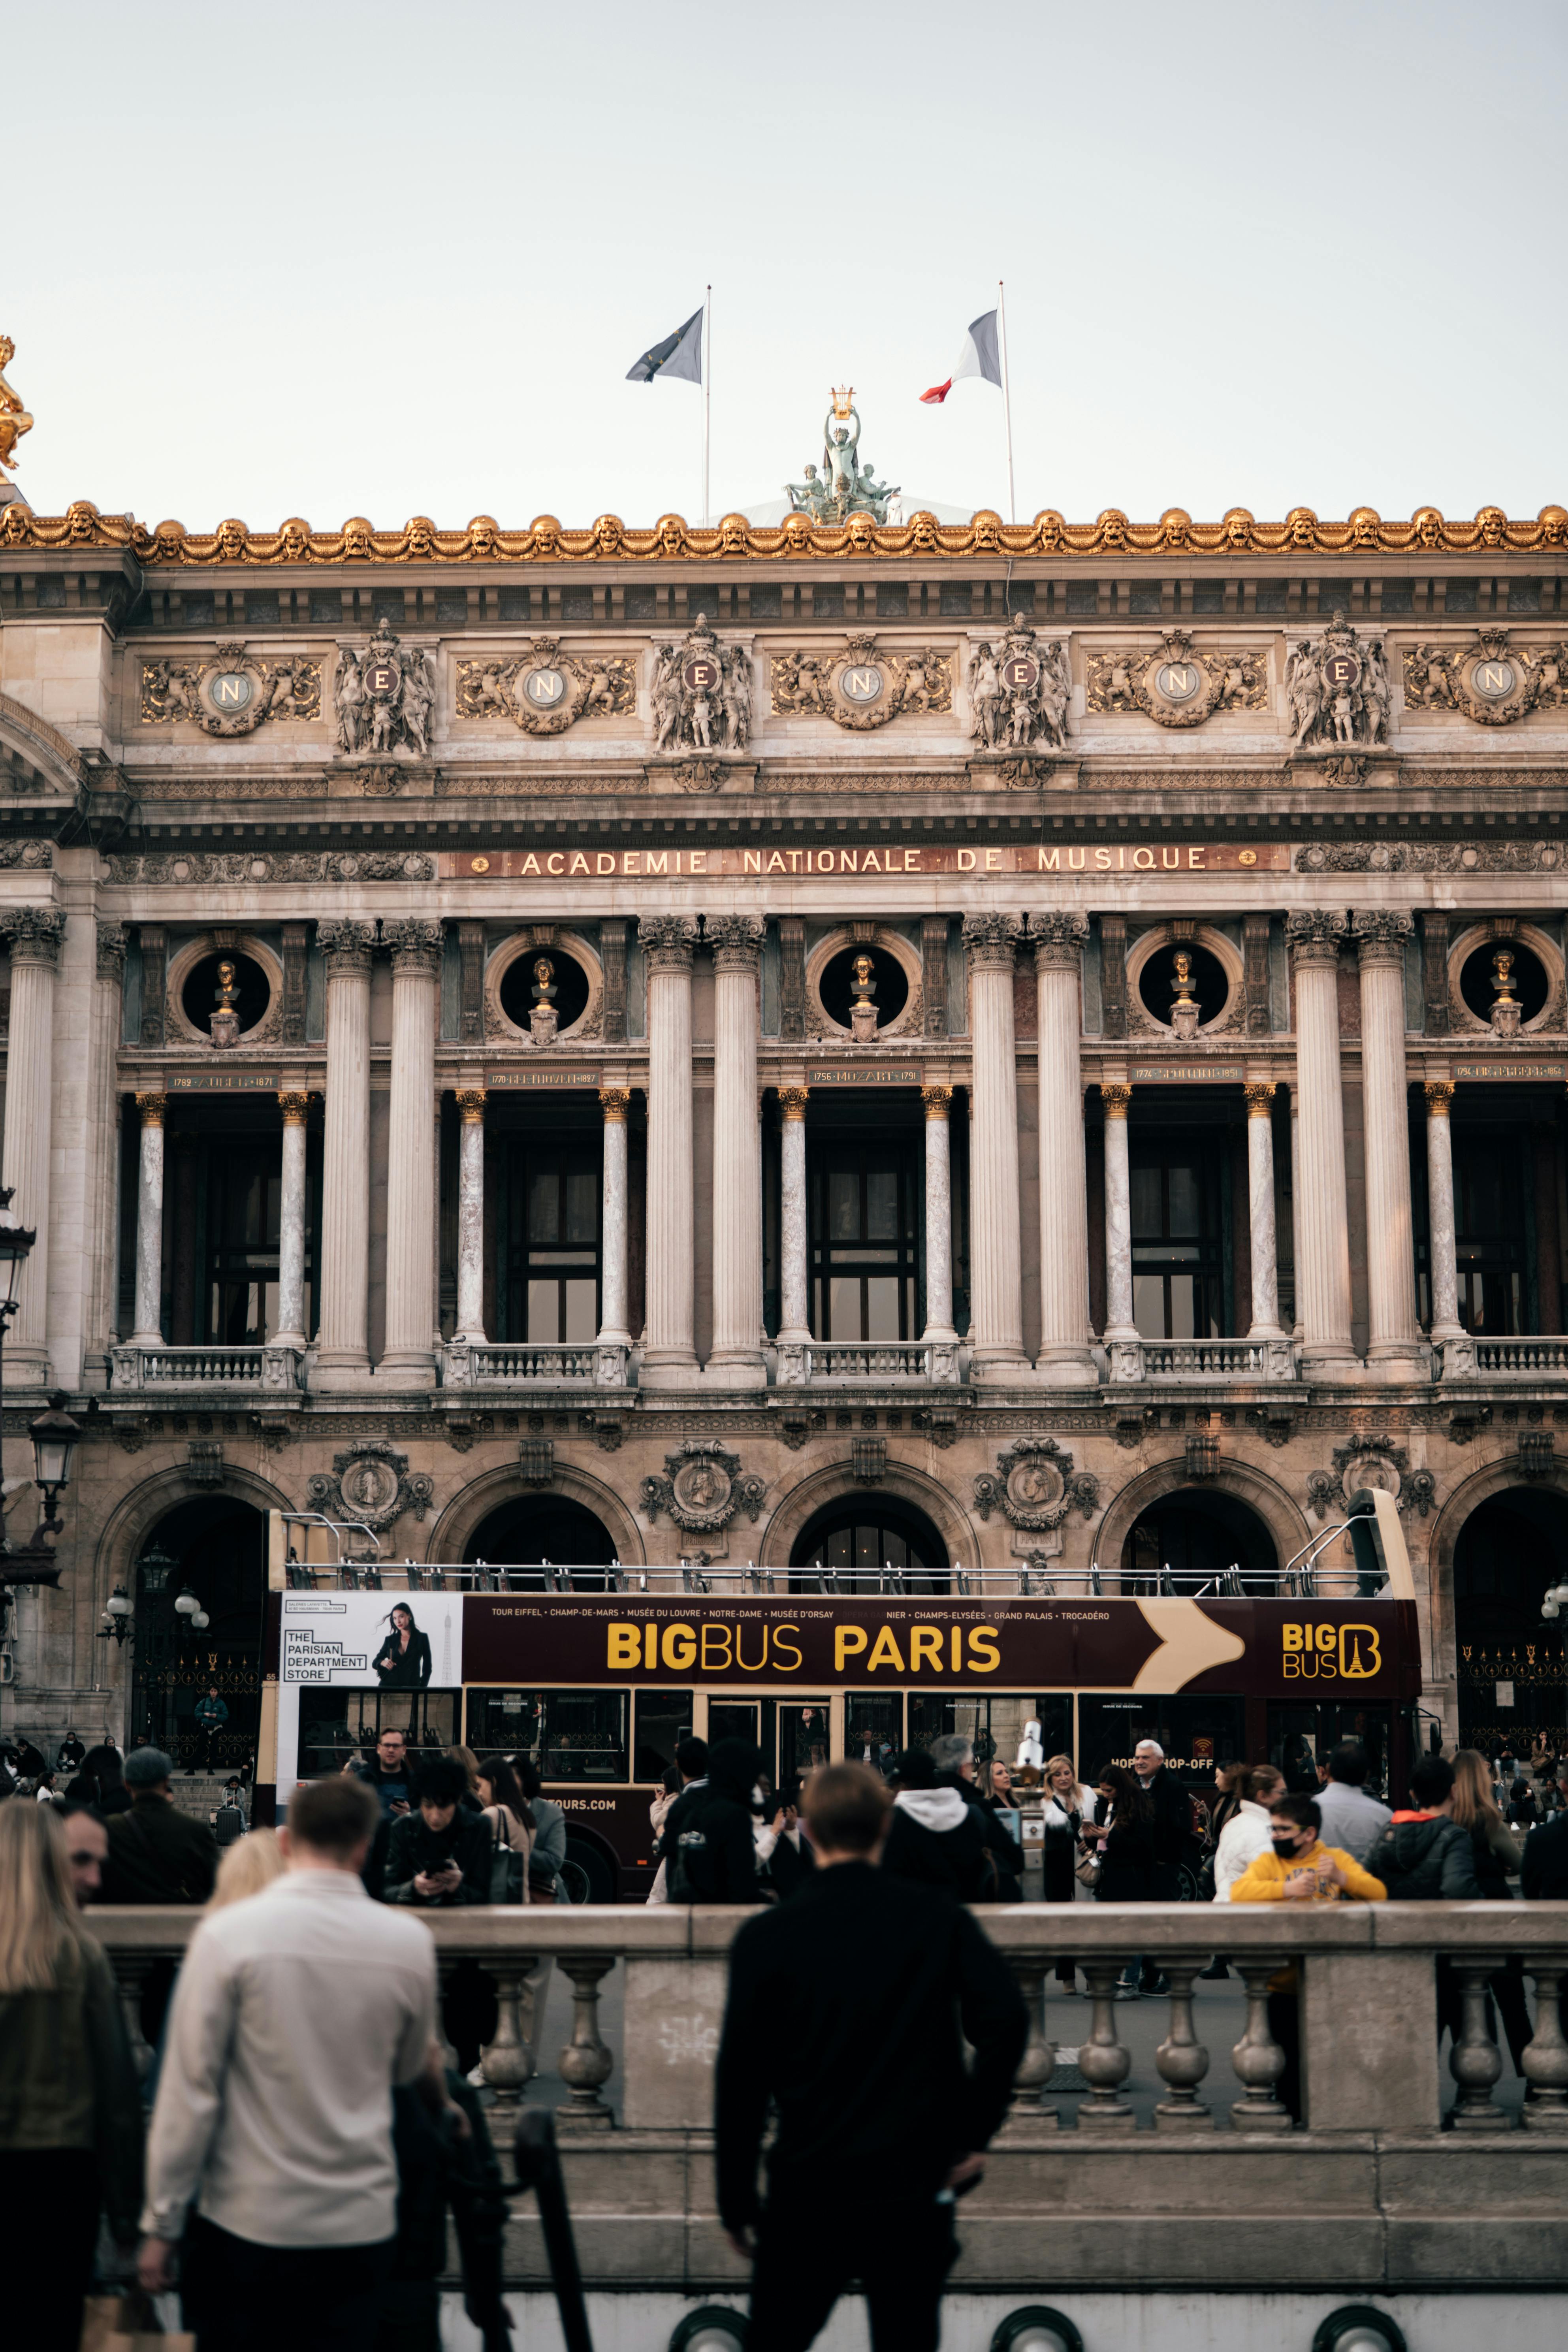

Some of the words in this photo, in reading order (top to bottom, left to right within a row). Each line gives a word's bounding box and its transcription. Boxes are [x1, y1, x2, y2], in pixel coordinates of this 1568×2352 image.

[375, 670, 389, 689] E
[694, 666, 708, 685] E
[1014, 665, 1028, 683] E
[1334, 662, 1349, 680] E
[1484, 668, 1503, 689] N
[536, 676, 555, 697] N
[851, 672, 871, 694] N
[1168, 670, 1188, 691] N
[221, 680, 240, 701] N
[521, 851, 707, 875] ACADEMIE
[744, 849, 922, 873] NATIONALE
[957, 848, 1003, 871] DE
[1038, 847, 1206, 870] MUSIQUE
[492, 1075, 506, 1084] 1770
[509, 1074, 576, 1084] BEETHOVEN
[814, 1072, 832, 1081] 1756
[837, 1071, 894, 1081] MOZART
[901, 1071, 916, 1080] 1791
[1136, 1070, 1152, 1078] 1774
[1222, 1069, 1238, 1077] 1851
[1457, 1067, 1472, 1075] 1794
[1547, 1067, 1562, 1075] 1864
[256, 1077, 273, 1086] 1871
[627, 1607, 655, 1617] MUSÉE
[770, 1608, 798, 1618] MUSÉE
[915, 1610, 986, 1619] CHAMPS-ELYSÉES
[1061, 1610, 1110, 1620] TROCADÉRO
[288, 1633, 310, 1642] THE
[1282, 1623, 1337, 1651] BIG
[288, 1645, 339, 1654] PARISIAN
[835, 1625, 1001, 1672] PARIS
[288, 1657, 363, 1667] DEPARTMENT
[1283, 1653, 1337, 1678] BUS
[548, 1799, 616, 1810] OURS.COM
